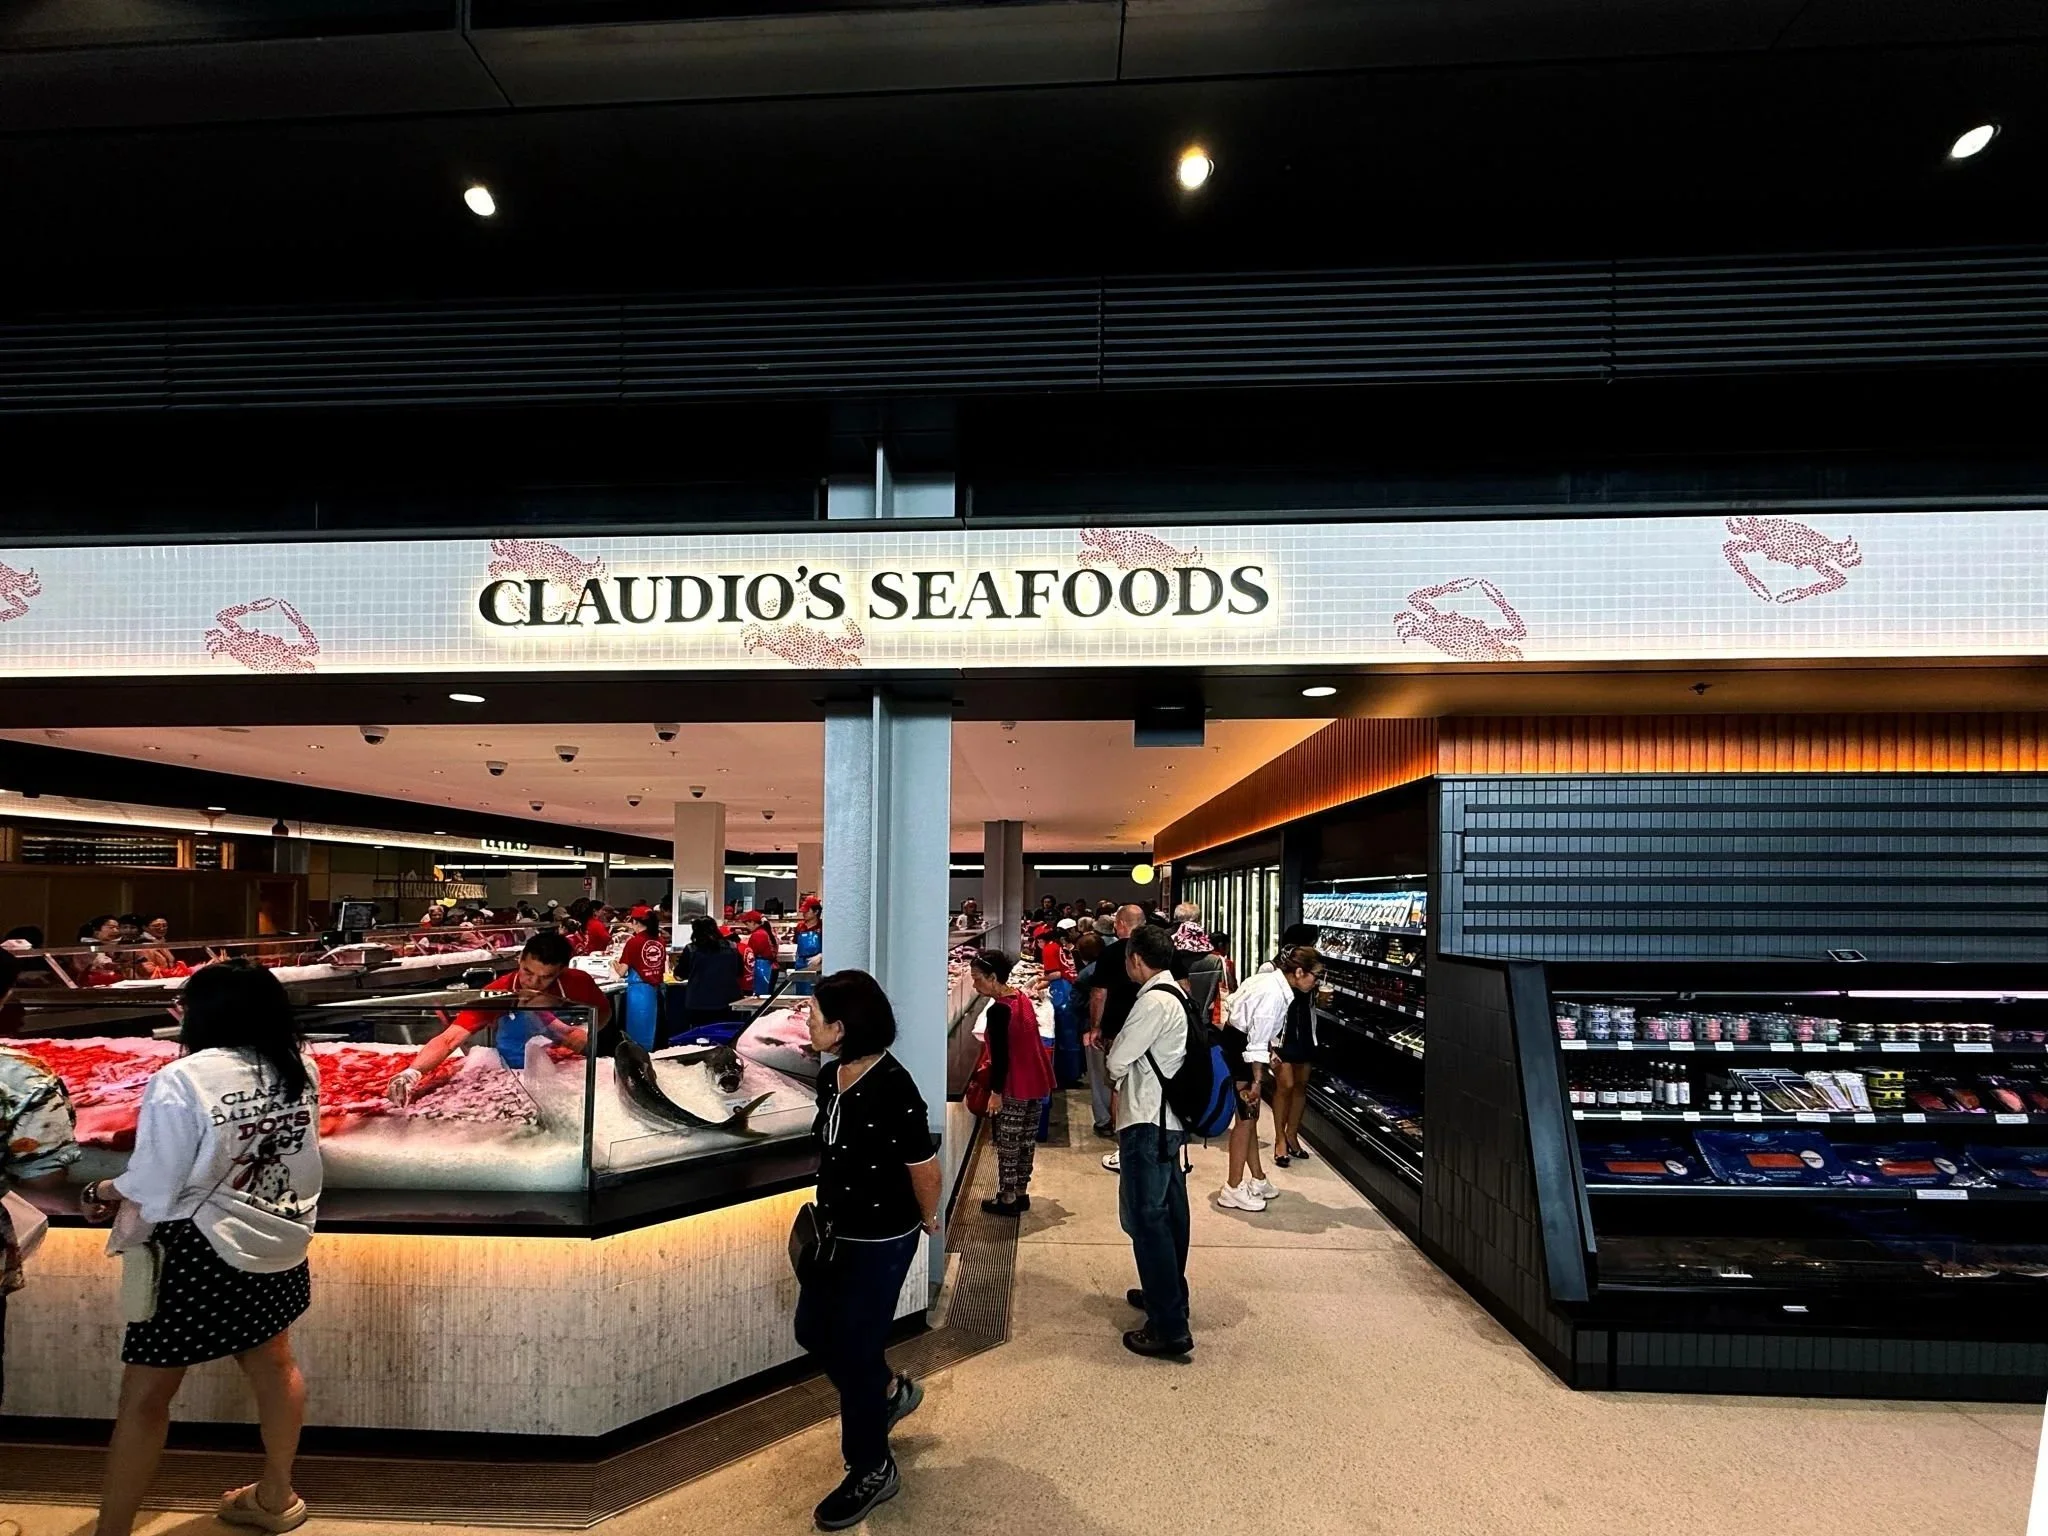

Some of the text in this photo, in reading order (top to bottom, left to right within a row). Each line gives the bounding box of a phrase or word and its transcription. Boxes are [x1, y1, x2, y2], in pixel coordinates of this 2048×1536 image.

[478, 564, 1270, 627] CLAUDIO'S SEAFOODS
[238, 1110, 311, 1141] DOTS
